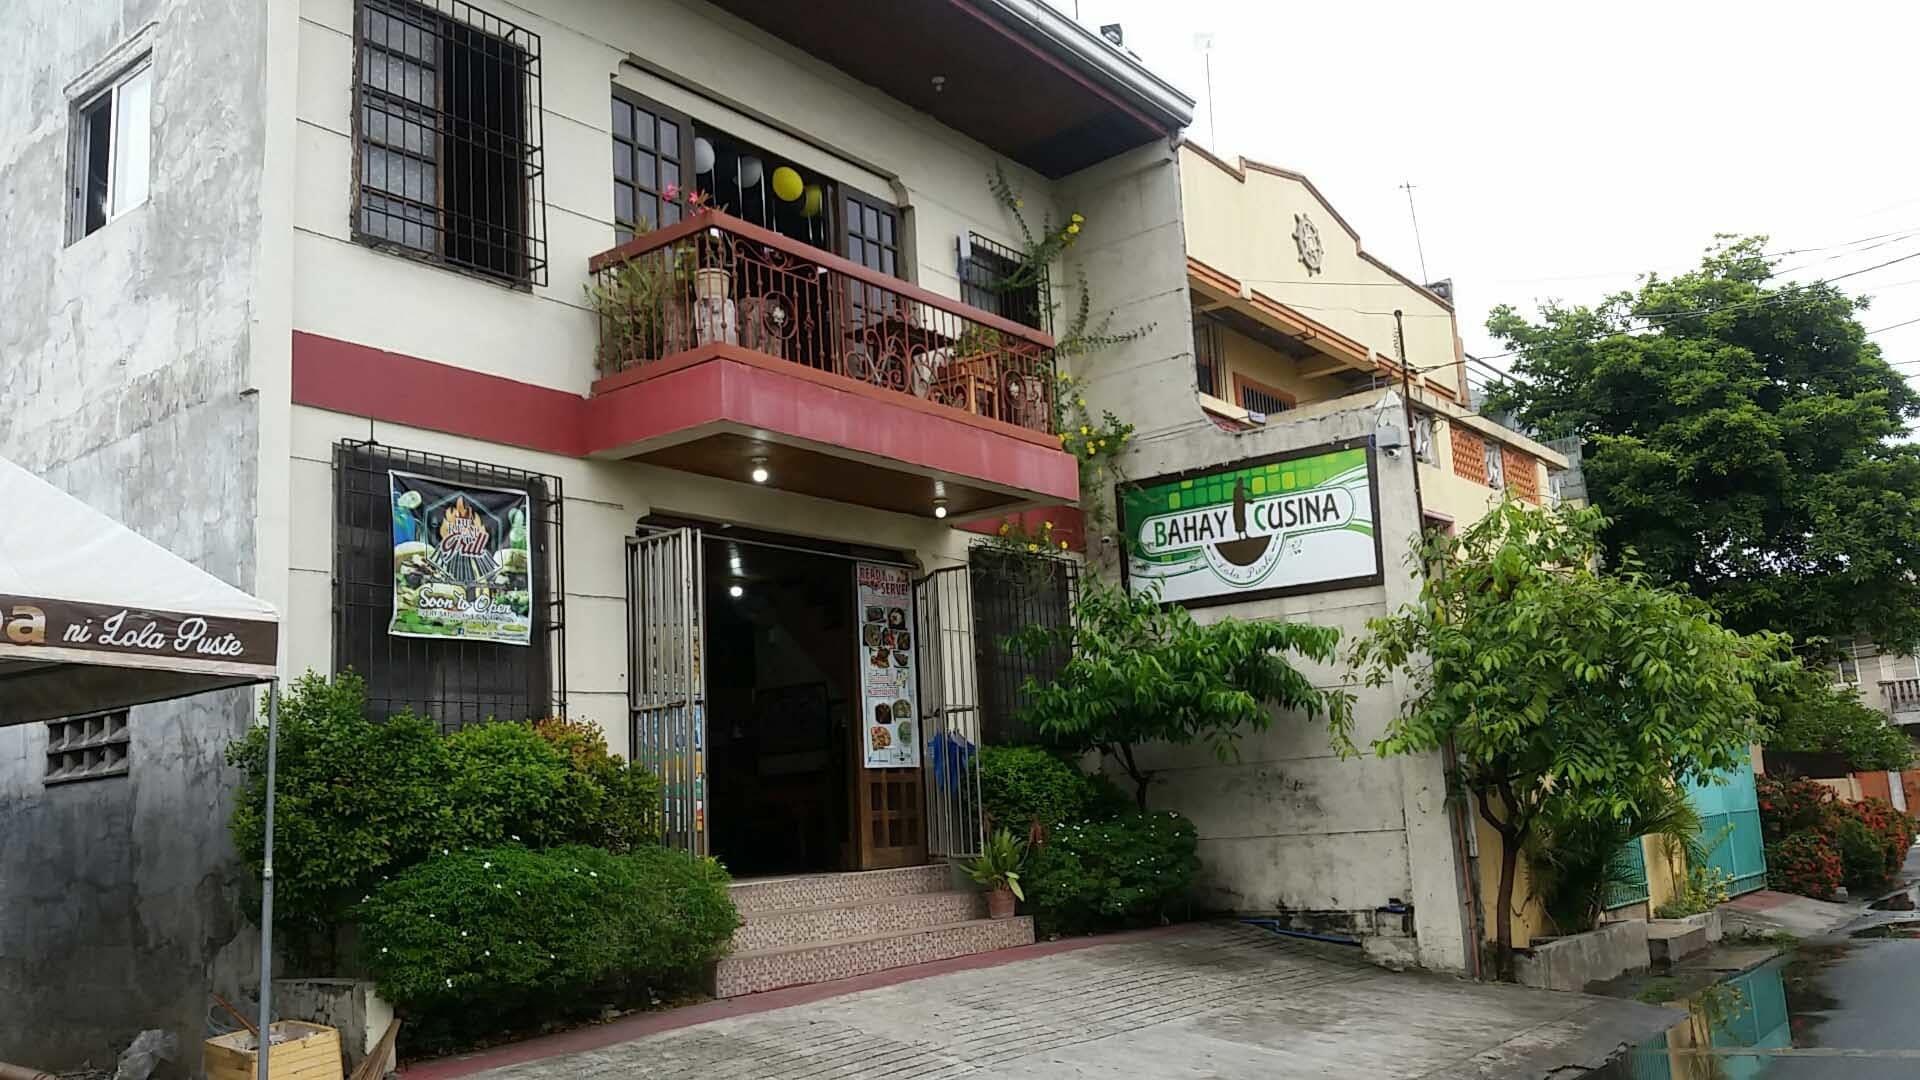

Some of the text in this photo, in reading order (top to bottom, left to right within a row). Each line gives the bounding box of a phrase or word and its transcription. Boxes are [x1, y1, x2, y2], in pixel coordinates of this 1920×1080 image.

[1154, 493, 1341, 548] BAHAY CUSINA
[442, 533, 488, 560] Grill
[1217, 563, 1240, 579] Lola
[419, 586, 512, 615] Soon to Open
[63, 618, 93, 643] ni
[98, 609, 166, 650] Lola
[173, 616, 244, 657] Puste
